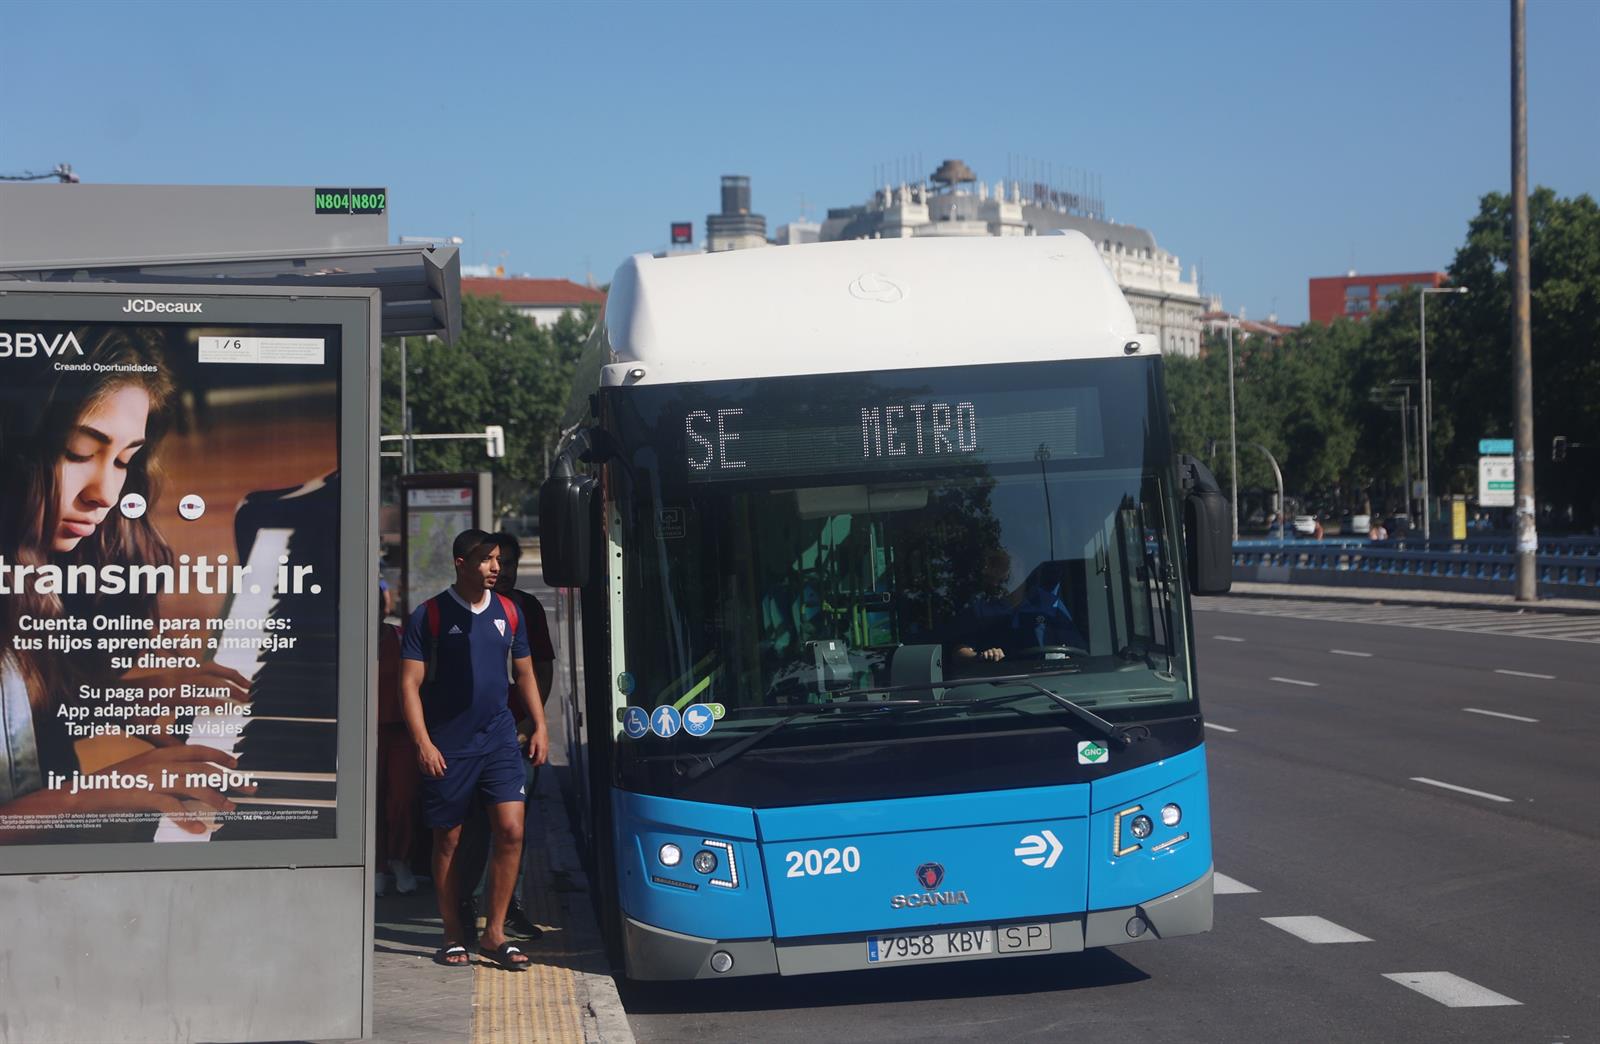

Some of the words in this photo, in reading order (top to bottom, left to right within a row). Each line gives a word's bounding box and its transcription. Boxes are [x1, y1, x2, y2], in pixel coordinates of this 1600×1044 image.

[316, 194, 349, 209] N804
[352, 194, 386, 209] N802
[122, 299, 203, 313] JCDecaux
[0, 331, 84, 358] BBVA
[233, 340, 242, 350] 6
[54, 362, 92, 371] Creando
[93, 363, 158, 373] Oportunidades
[685, 408, 747, 470] SE
[861, 402, 977, 457] METRO
[0, 554, 261, 594] transmitir.
[278, 554, 322, 594] ir.
[18, 615, 87, 631] Cuenta
[92, 614, 154, 631] Online
[159, 618, 200, 635] para
[206, 618, 291, 630] menores:
[13, 635, 43, 650] tus
[48, 634, 92, 654] hijos
[97, 634, 202, 654] aprenderán
[207, 637, 218, 649] a
[223, 633, 297, 652] manejar
[111, 656, 133, 669] su
[137, 654, 201, 669] dinero.
[79, 685, 101, 699] Su
[105, 687, 144, 702] paga
[149, 687, 176, 702] por
[180, 684, 231, 698] Bizum
[57, 704, 90, 720] App
[93, 703, 170, 720] adaptada
[175, 705, 210, 719] para
[214, 702, 252, 716] ellos
[715, 705, 721, 714] 3
[65, 721, 121, 739] Tarjeta
[126, 724, 161, 738] para
[166, 723, 193, 735] sus
[198, 721, 244, 737] viajes
[48, 771, 66, 790] ir
[70, 770, 155, 795] juntos,
[161, 769, 179, 789] ir
[185, 768, 259, 792] mejor.
[785, 846, 861, 878] 2020
[891, 891, 969, 909] SCANIA
[883, 935, 934, 958] 7958
[947, 931, 985, 953] KBV
[1006, 926, 1042, 948] SP
